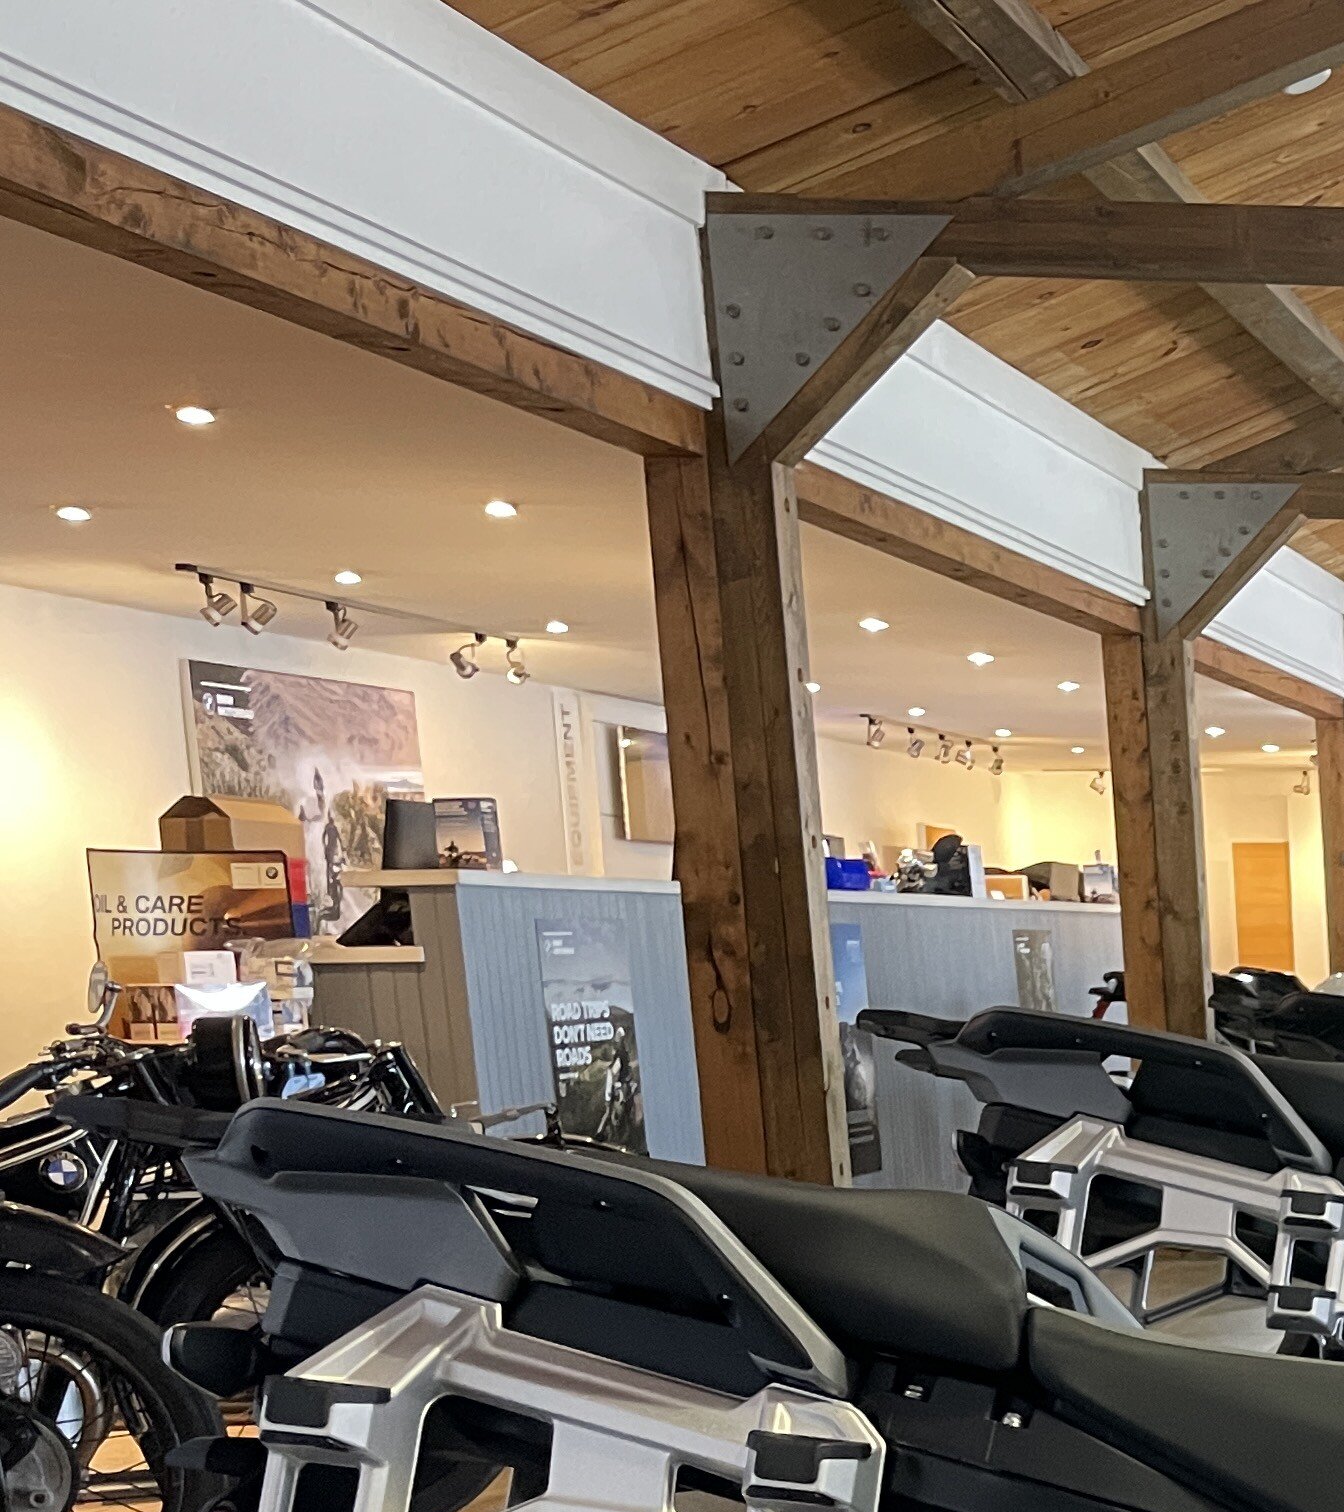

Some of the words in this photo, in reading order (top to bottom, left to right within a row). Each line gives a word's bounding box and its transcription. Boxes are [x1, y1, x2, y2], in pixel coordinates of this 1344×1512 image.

[560, 703, 584, 866] EQUIPMENT
[117, 895, 128, 914] &
[136, 895, 204, 914] CARE
[551, 1003, 581, 1021] ROAD
[582, 1000, 610, 1019] TRIPS
[587, 1022, 614, 1041] NEED
[556, 1046, 592, 1067] ROADS
